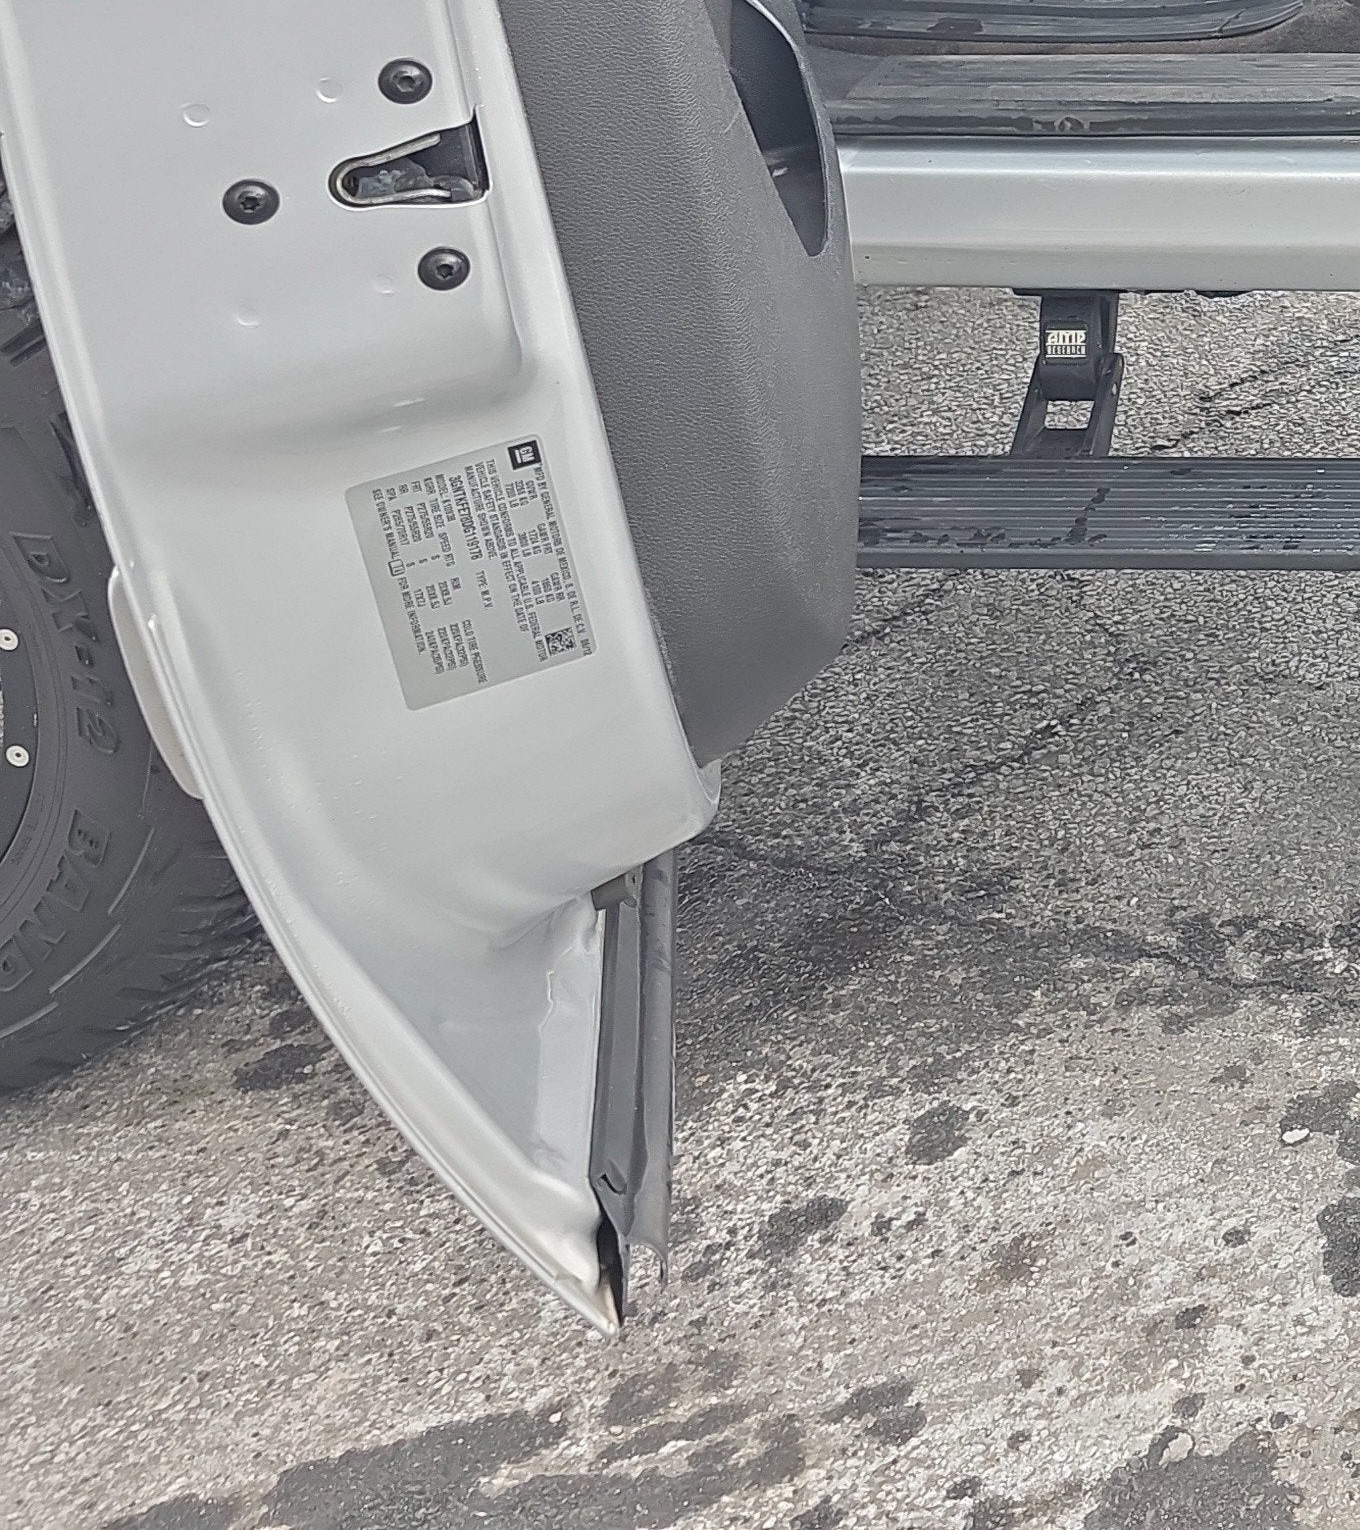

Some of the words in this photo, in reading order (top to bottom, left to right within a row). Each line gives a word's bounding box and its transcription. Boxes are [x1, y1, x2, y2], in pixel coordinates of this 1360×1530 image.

[521, 447, 533, 461] GM
[475, 461, 490, 488] VEHICLE
[486, 459, 497, 474] THIS
[372, 488, 384, 500] SEE
[490, 475, 504, 501] VEHICLE
[464, 464, 484, 512] MANUFACTURE
[477, 512, 491, 536] SHOWN
[482, 489, 496, 513] SAFETY
[433, 513, 445, 529] SIZE
[497, 502, 514, 537] CONFORMS
[540, 491, 555, 520] GENERAL
[548, 520, 562, 546] MOTORS
[384, 531, 400, 559] MANUAL
[438, 531, 451, 553] SPEED
[507, 538, 517, 547] TO
[509, 547, 520, 560] ALL
[501, 560, 515, 582] EFFECT
[513, 560, 530, 597] APPLICABLE
[397, 576, 409, 590] FOR
[401, 591, 414, 609] MORE
[510, 594, 521, 607] THE
[514, 607, 526, 624] DATE
[526, 612, 541, 639] FEDERAL
[518, 623, 528, 633] OF
[9, 532, 121, 755] DX-12
[534, 639, 547, 662] MOTOR
[470, 651, 487, 684] PRESSURE
